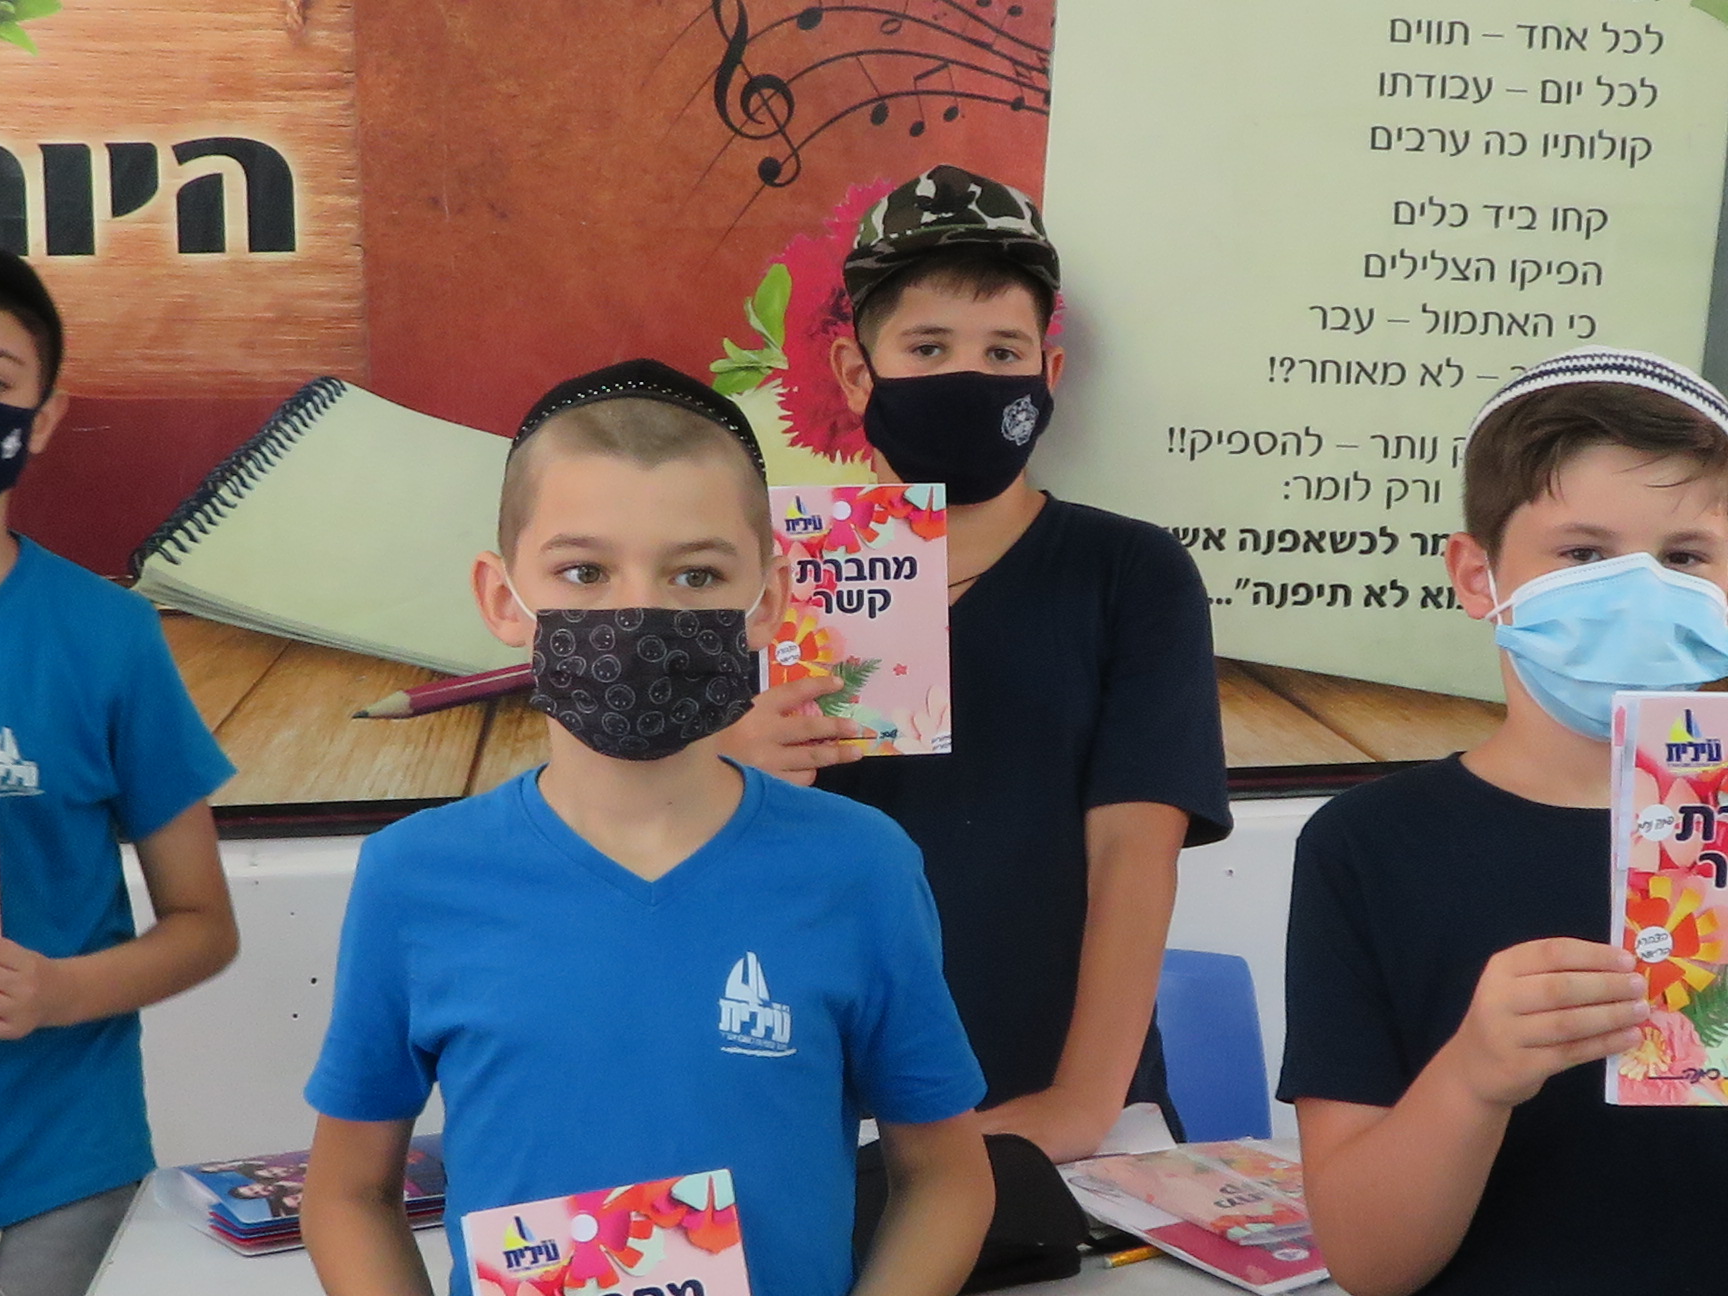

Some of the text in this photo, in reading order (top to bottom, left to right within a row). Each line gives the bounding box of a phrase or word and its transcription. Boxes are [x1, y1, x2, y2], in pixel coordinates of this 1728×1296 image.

[1389, 17, 1470, 47] תווים
[1516, 24, 1589, 52] אחד
[1601, 21, 1664, 55] לכל
[1378, 71, 1493, 105] עבודתו
[1540, 78, 1583, 106] יום
[1595, 74, 1658, 109] לכל
[1370, 125, 1653, 169] קולותיו כה ערבים
[1393, 195, 1609, 241] קחו ביד כלים
[1363, 247, 1603, 292] הפיקו הצלילים
[1308, 305, 1375, 336] עבר
[1421, 302, 1554, 338] האתמול
[1568, 314, 1597, 340] כי
[1268, 355, 1407, 387] מאוחר?!
[1419, 356, 1465, 389] לא
[1167, 425, 1324, 462] להספיק!!
[1369, 434, 1439, 465] נותר
[1283, 470, 1441, 511] ורק לומר:
[1238, 525, 1400, 556] לכשאפנה
[795, 555, 918, 584] מחברת
[813, 588, 892, 619] קשר
[1363, 578, 1410, 609] לא
